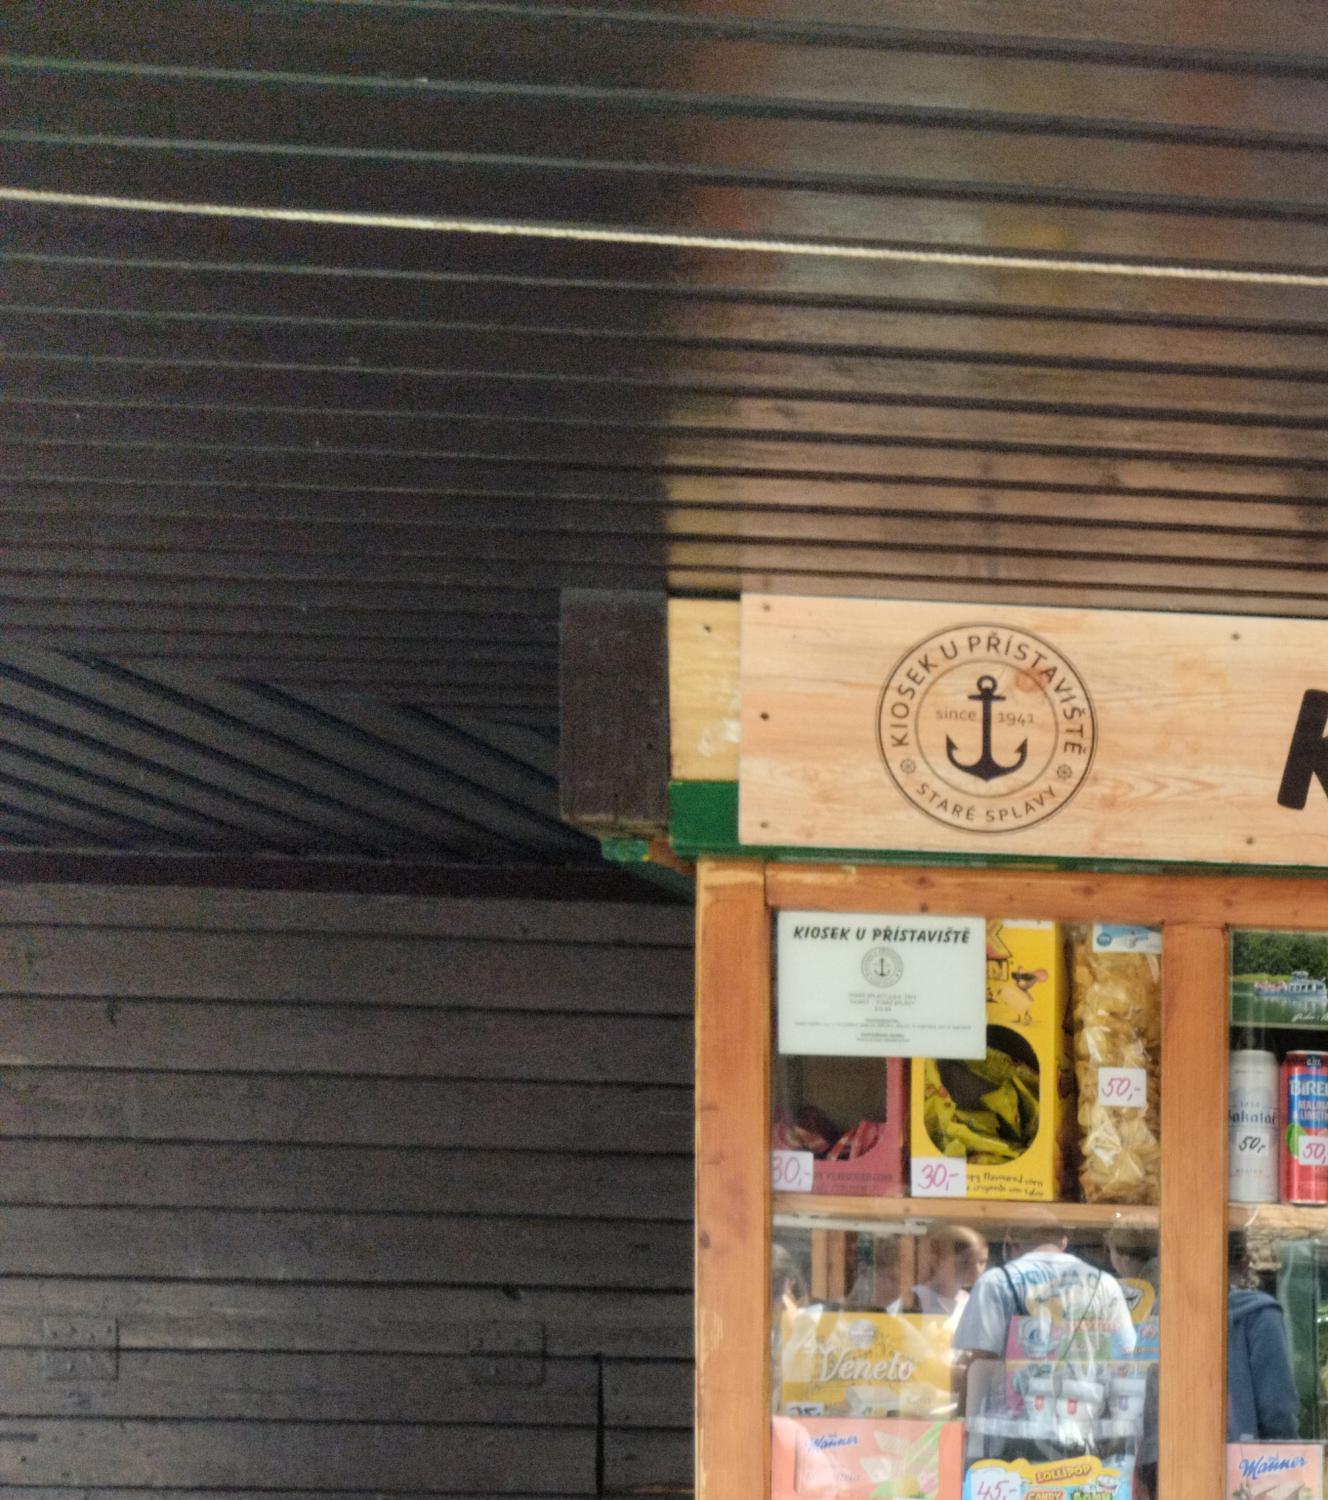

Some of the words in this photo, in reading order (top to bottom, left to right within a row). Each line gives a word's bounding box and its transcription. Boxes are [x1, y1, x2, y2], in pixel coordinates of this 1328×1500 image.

[890, 654, 939, 748] KIOSEK
[940, 640, 958, 660] U
[967, 632, 1087, 755] PŘÍSTAVIŠTĚ
[916, 782, 975, 821] STARÉ
[985, 785, 1056, 822] SPLAVY
[793, 925, 850, 940] KIOSEK
[856, 928, 867, 941] U
[872, 924, 970, 944] PŘÍSTAVIŠTĚ
